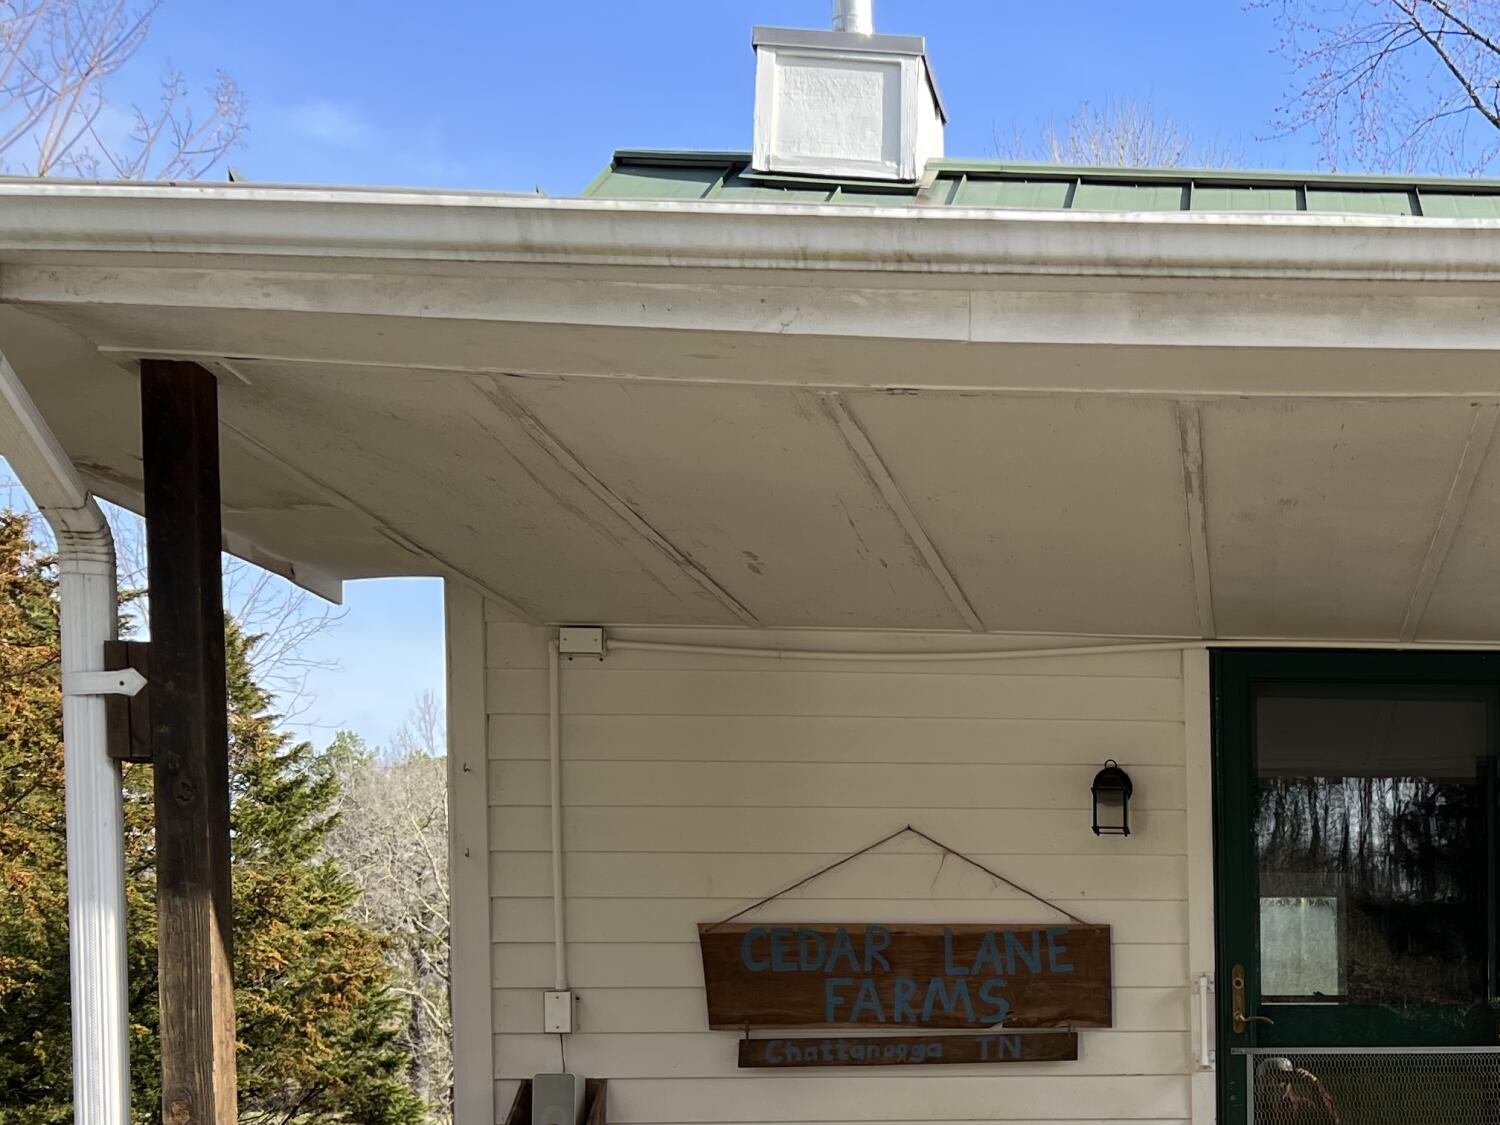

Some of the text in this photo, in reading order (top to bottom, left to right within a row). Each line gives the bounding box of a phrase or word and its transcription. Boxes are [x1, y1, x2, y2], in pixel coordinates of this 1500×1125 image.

[740, 926, 1073, 975] CEDAR LANE
[825, 977, 1011, 1023] FARMS
[765, 1036, 1021, 1064] Chattanooga TN
